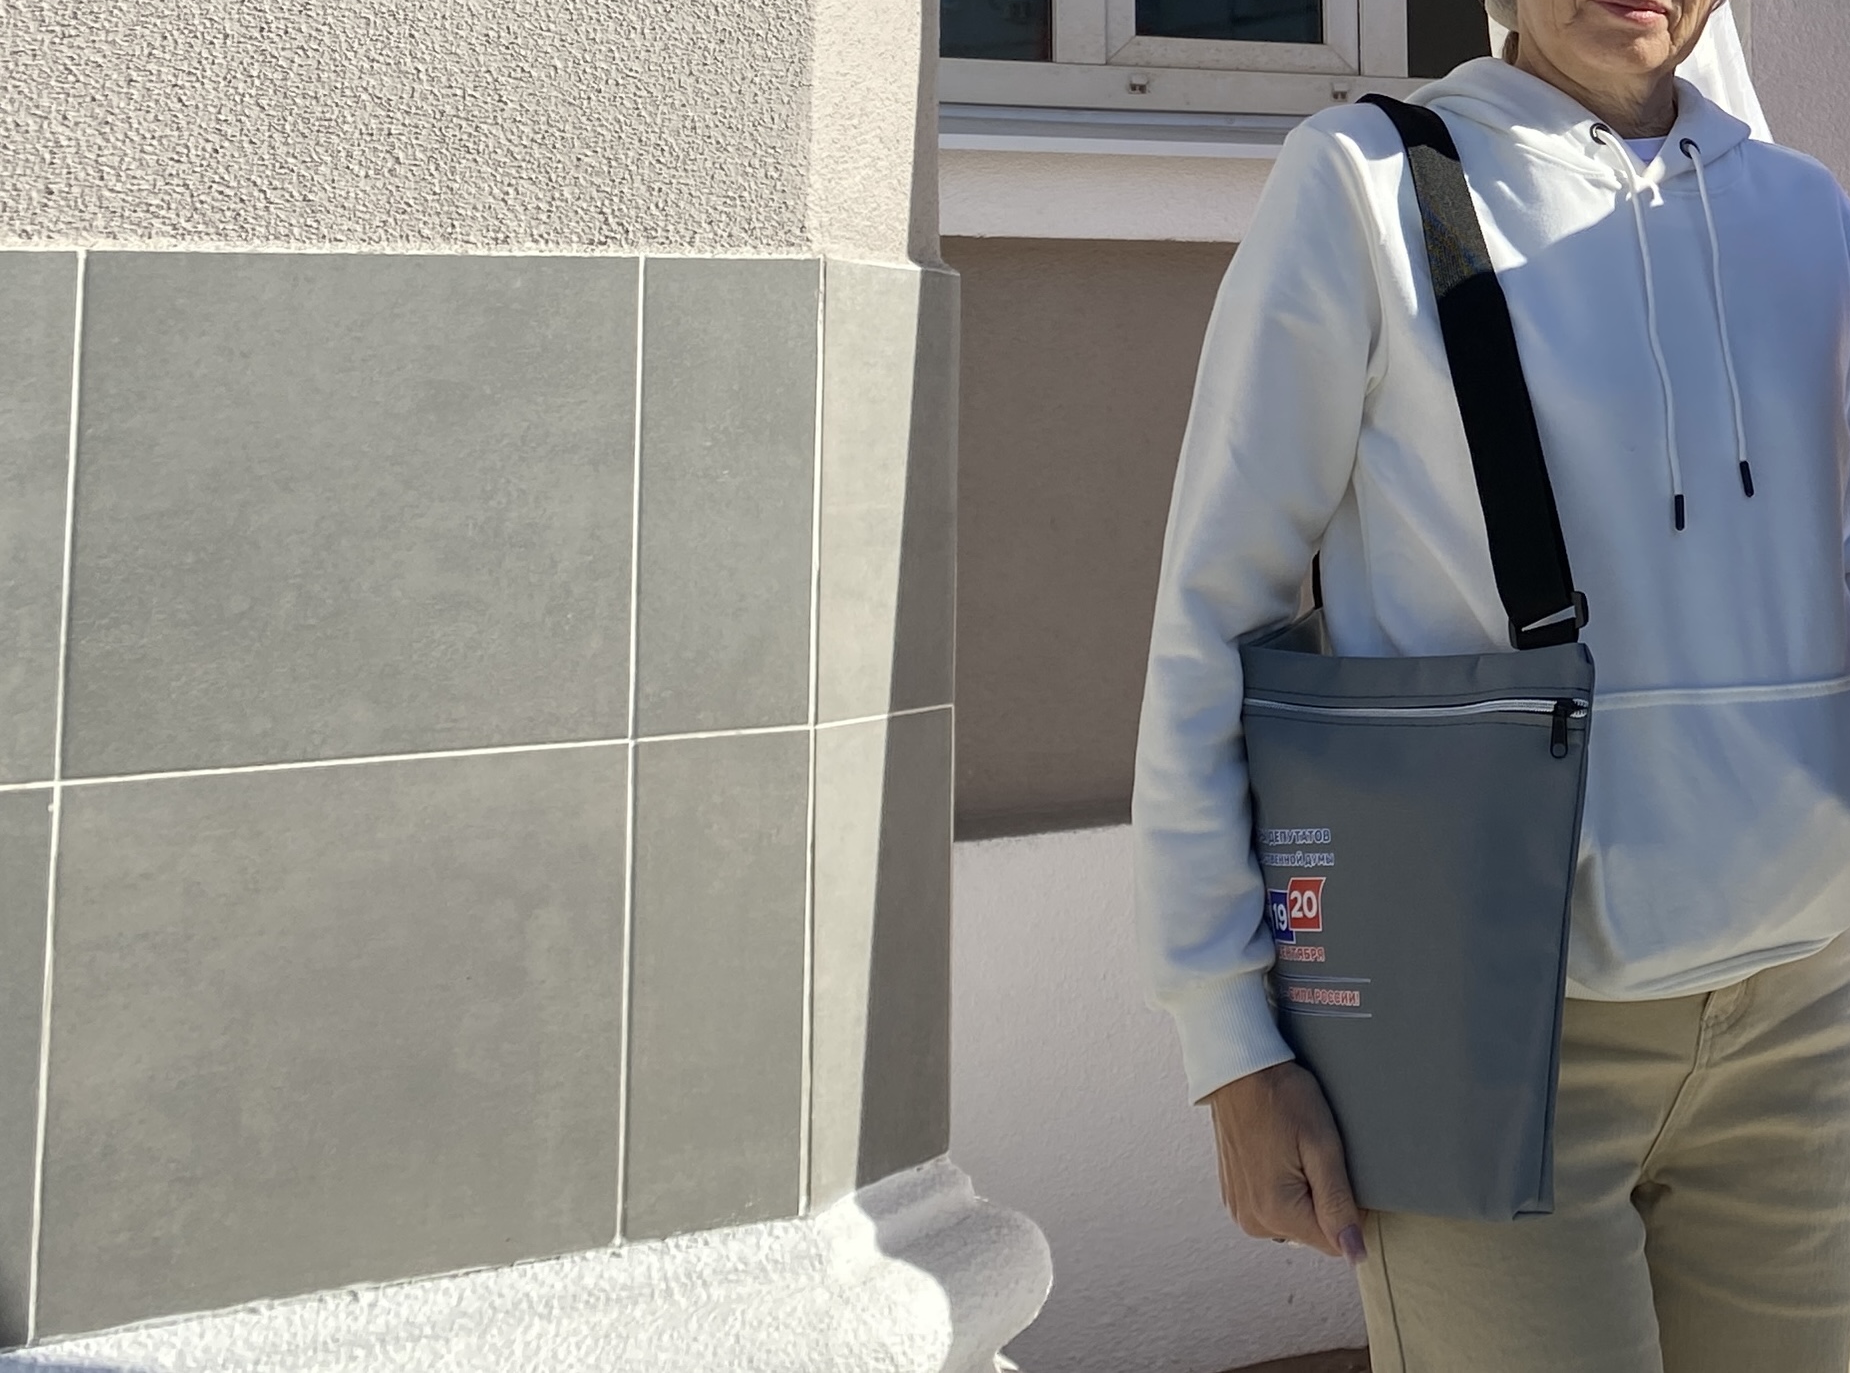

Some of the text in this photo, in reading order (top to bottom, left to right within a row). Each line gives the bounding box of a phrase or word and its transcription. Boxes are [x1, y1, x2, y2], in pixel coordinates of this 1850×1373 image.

[1268, 828, 1331, 846] ДЕПУТАТОВ
[1304, 853, 1335, 868] ДУМЫ
[1273, 889, 1318, 931] 19 20
[1314, 988, 1361, 1006] РОССИИ!
